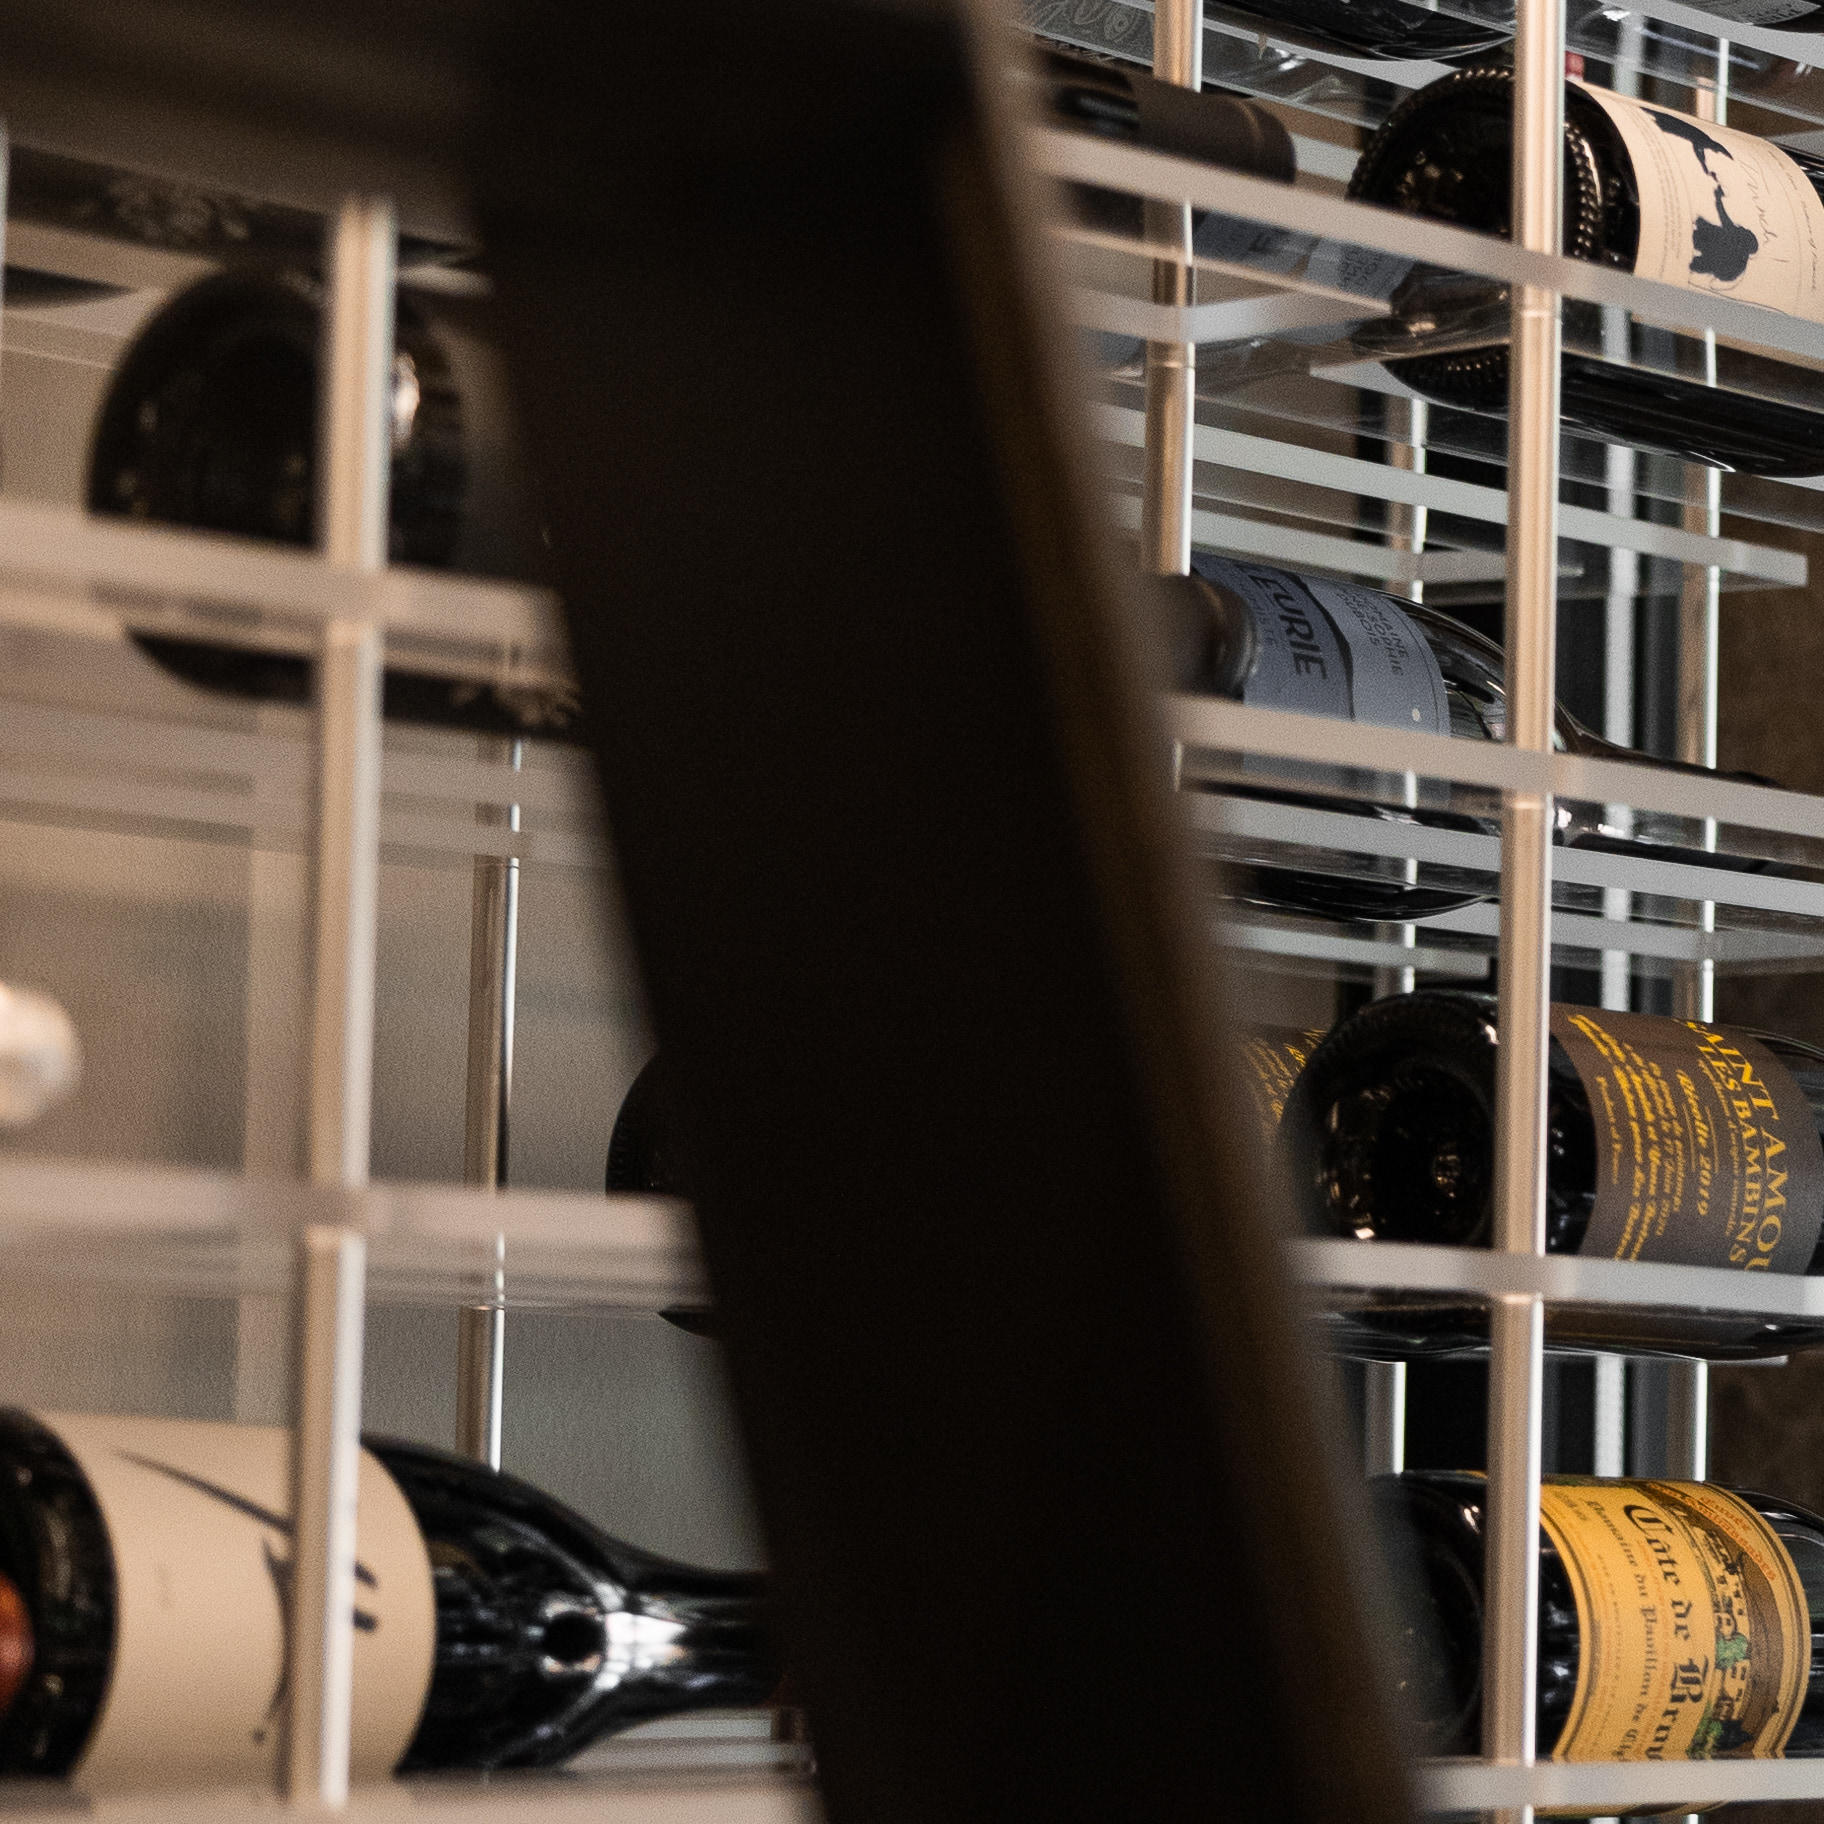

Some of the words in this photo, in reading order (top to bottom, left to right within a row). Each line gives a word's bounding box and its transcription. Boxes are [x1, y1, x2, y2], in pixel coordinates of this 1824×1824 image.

[1697, 1153, 1710, 1215] 2019
[1698, 1045, 1741, 1090] LES
[1729, 1099, 1762, 1263] BAMBINS
[1625, 1505, 1683, 1586] Côte
[1672, 1601, 1693, 1641] de
